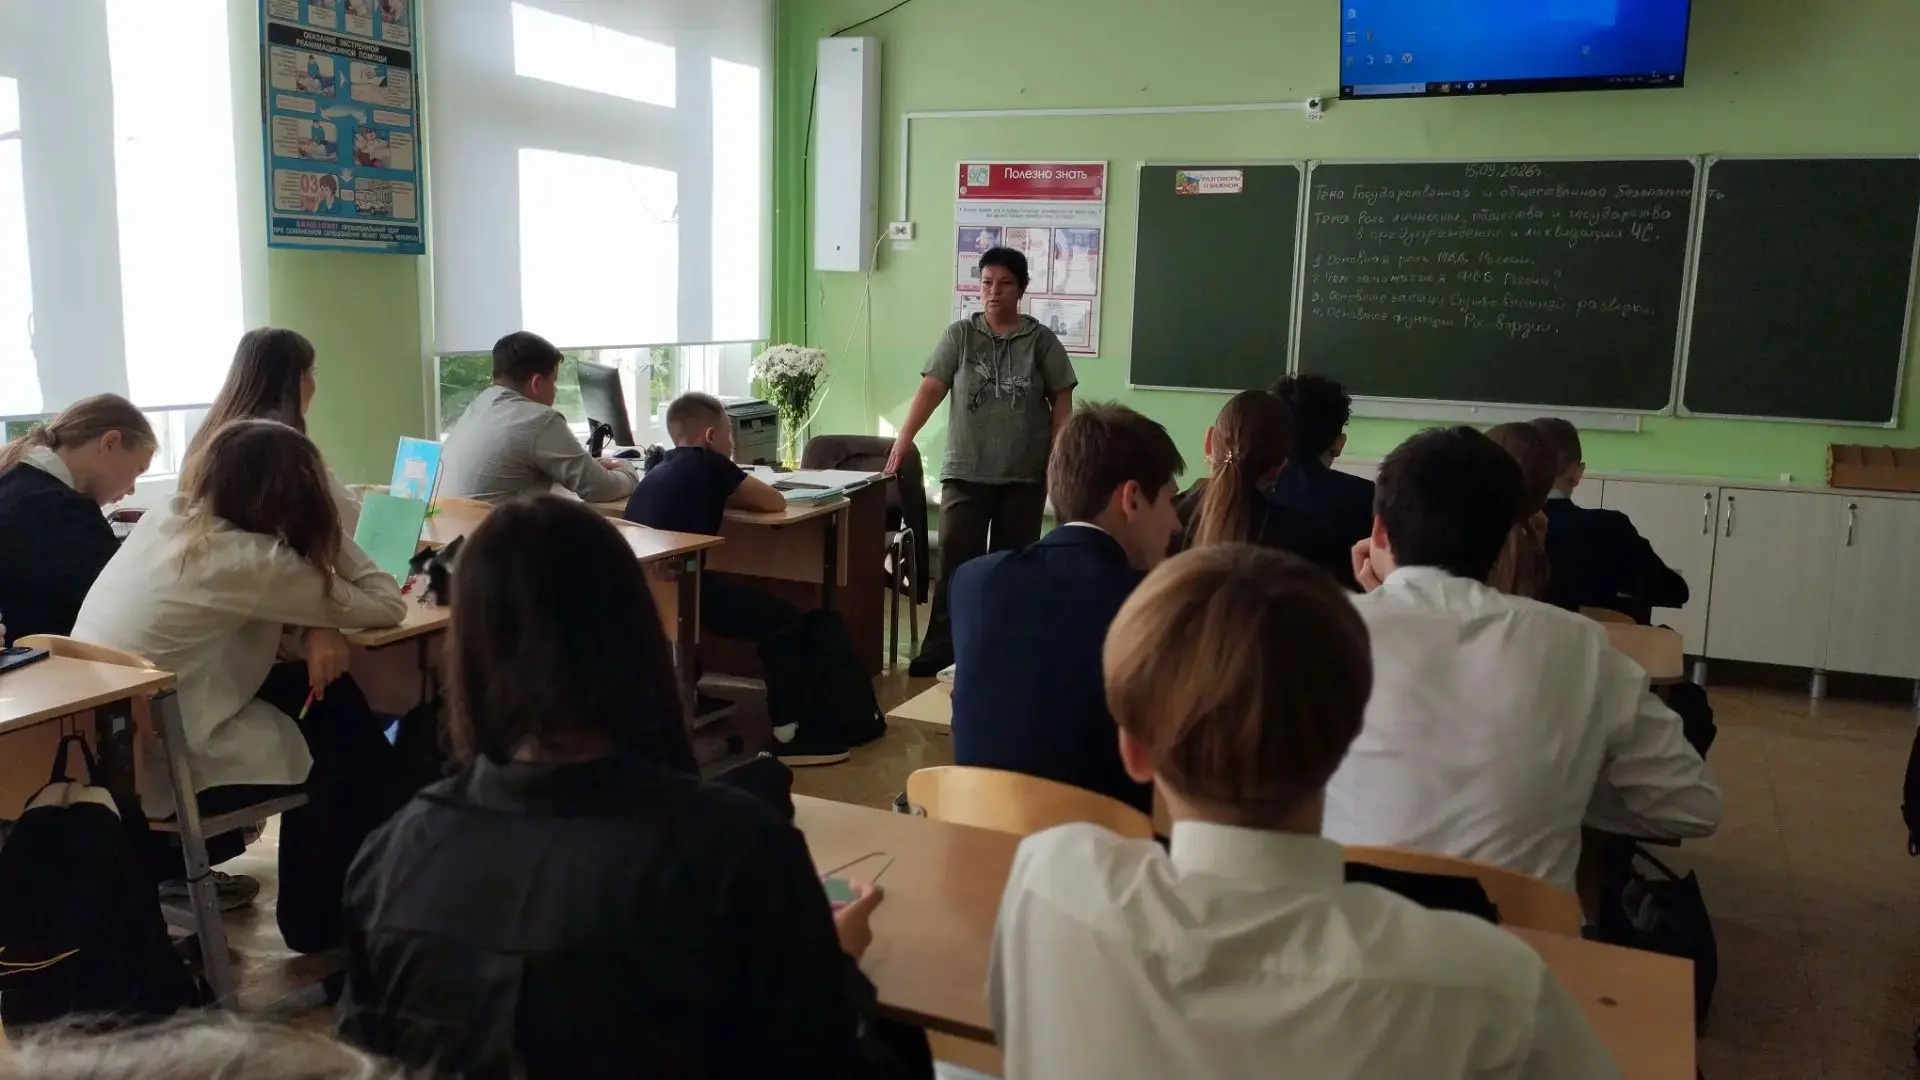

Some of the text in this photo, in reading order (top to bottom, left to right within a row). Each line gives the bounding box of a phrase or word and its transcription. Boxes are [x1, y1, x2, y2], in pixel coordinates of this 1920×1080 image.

[1004, 167, 1088, 179] Полезно знать
[301, 173, 319, 194] 03
